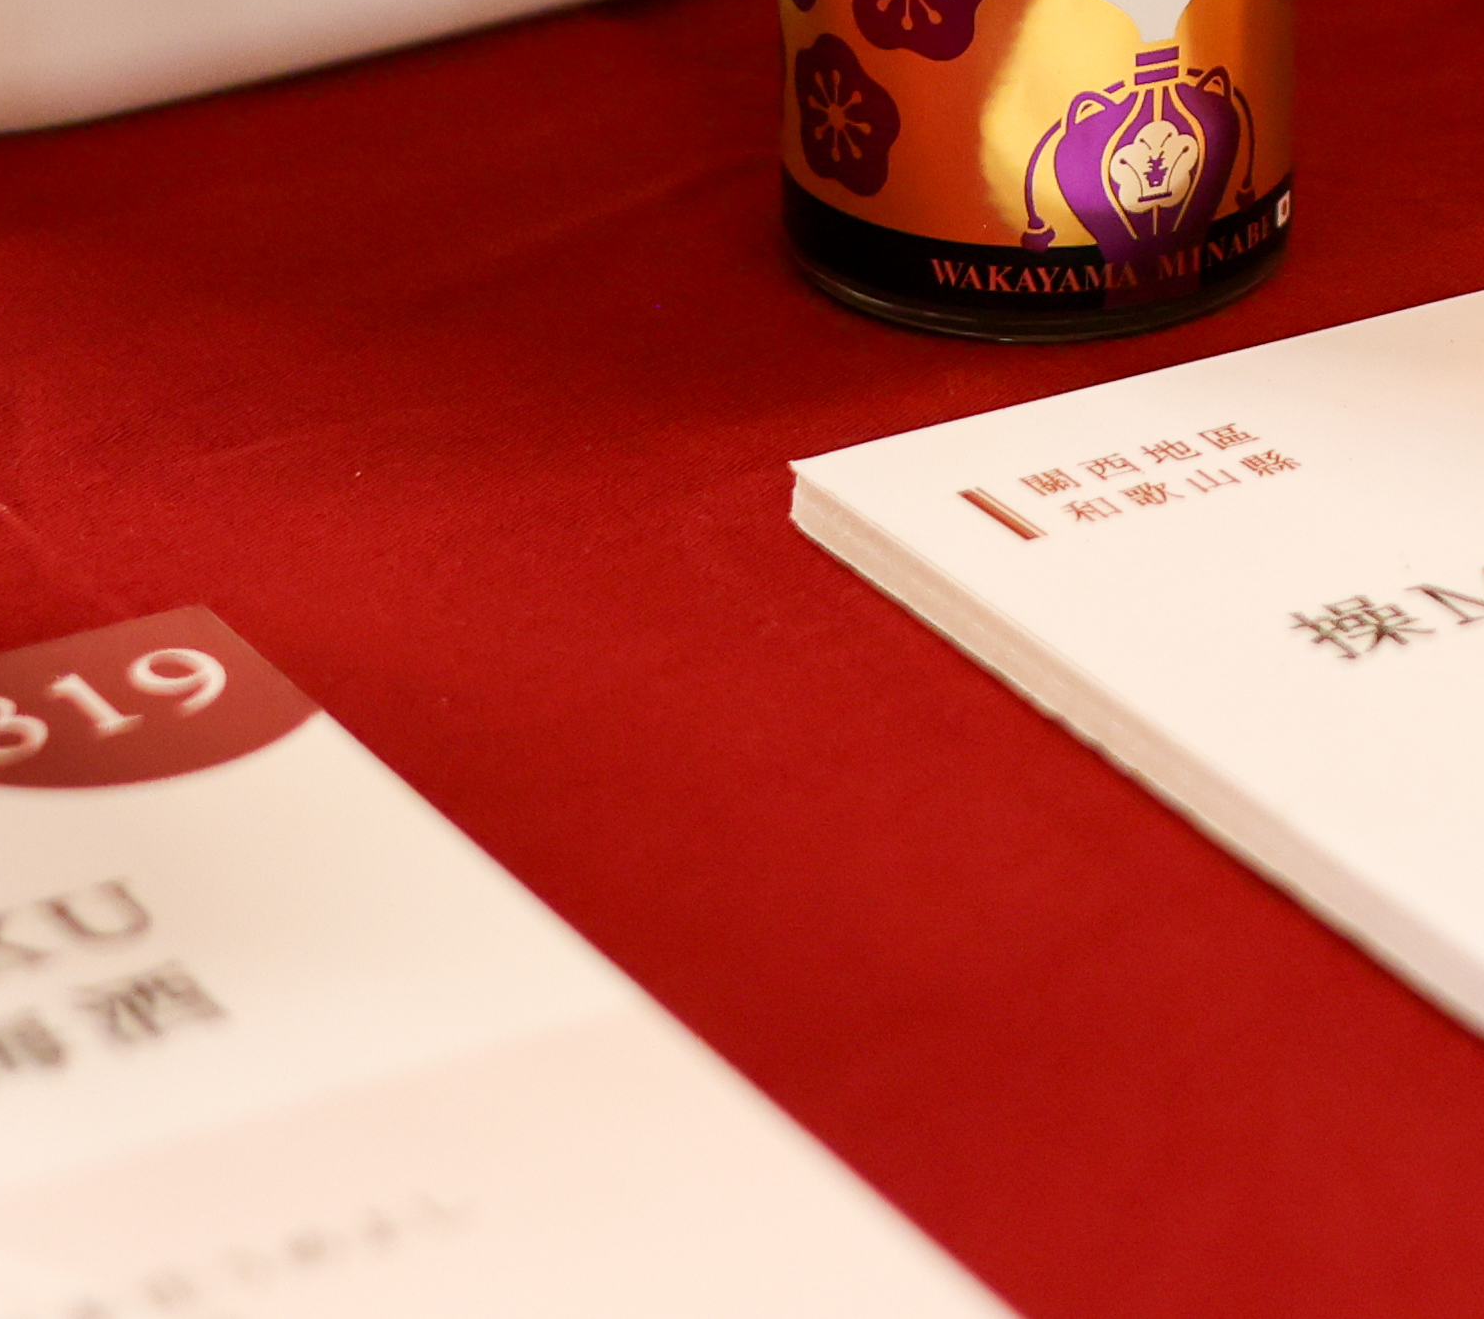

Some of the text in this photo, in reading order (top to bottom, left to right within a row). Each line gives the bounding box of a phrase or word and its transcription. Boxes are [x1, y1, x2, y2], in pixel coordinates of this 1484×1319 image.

[930, 255, 1140, 294] WAKAYAMA
[1059, 447, 1305, 526] 和歌山縣
